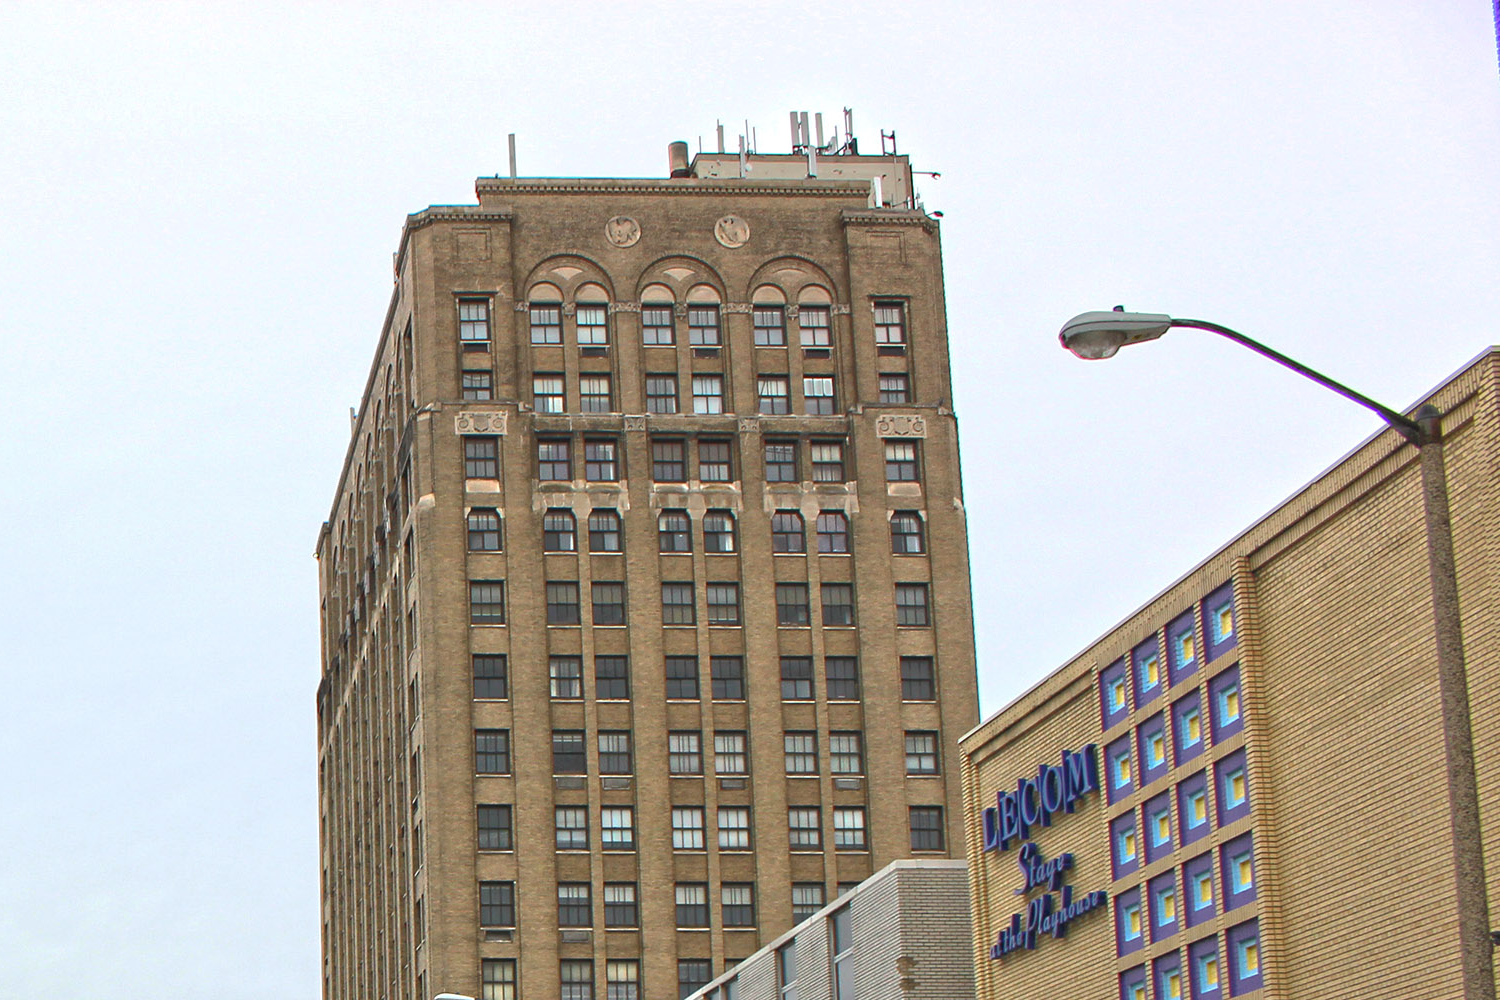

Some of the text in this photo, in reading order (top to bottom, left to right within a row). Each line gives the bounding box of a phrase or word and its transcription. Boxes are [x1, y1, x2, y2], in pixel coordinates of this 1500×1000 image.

[981, 744, 1099, 852] LECOM
[1014, 842, 1072, 895] Stage
[1000, 914, 1025, 953] the
[1024, 886, 1107, 950] Playhouse
